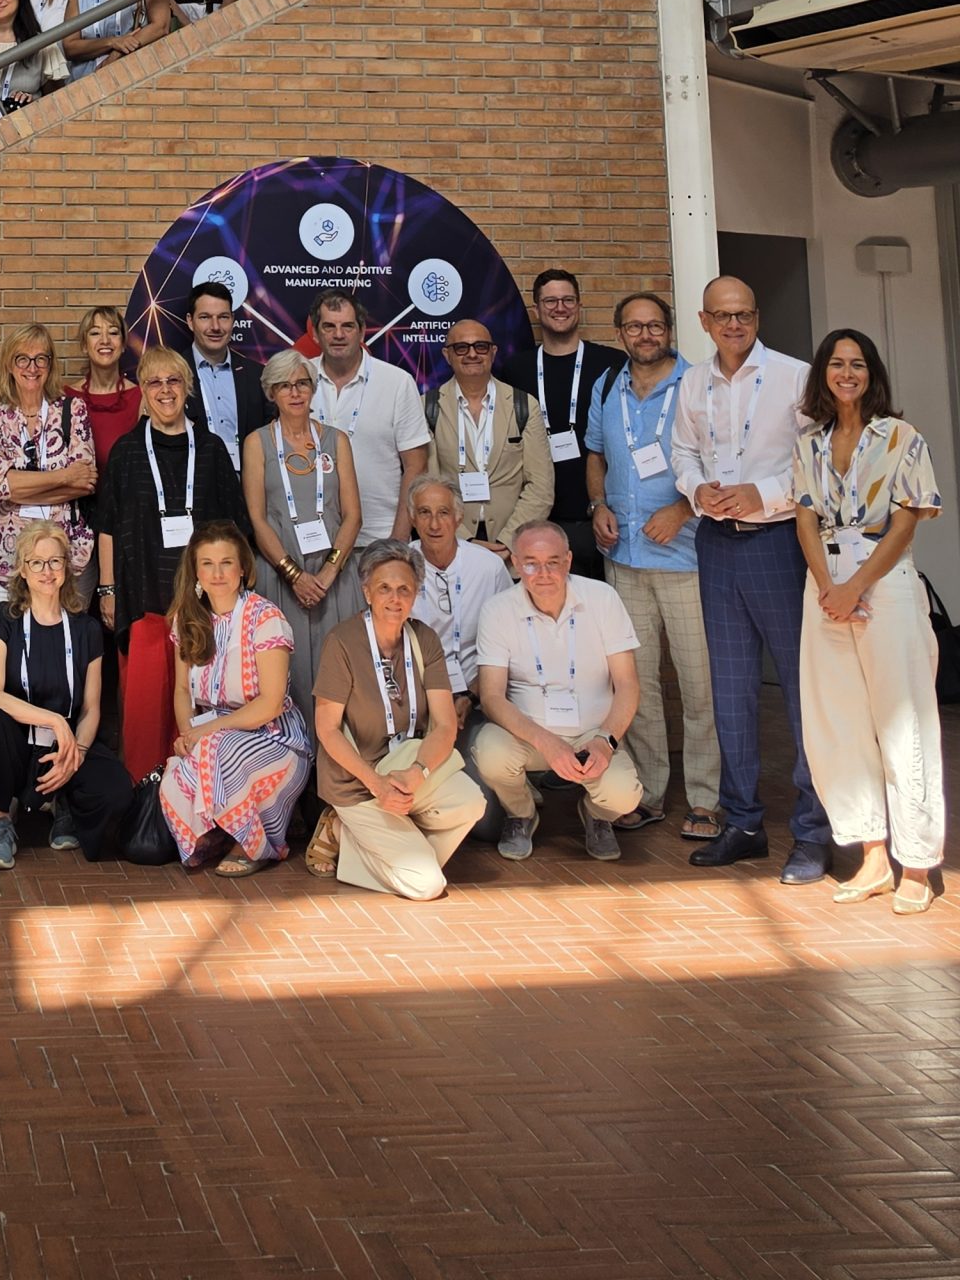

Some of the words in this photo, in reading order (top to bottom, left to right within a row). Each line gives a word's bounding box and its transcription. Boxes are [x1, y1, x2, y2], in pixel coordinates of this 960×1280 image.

[263, 265, 320, 274] ADVANCED
[321, 265, 344, 275] AND
[345, 266, 393, 275] ADDITIVE
[285, 278, 372, 288] MANUFACTURING
[232, 320, 253, 329] ART
[409, 321, 455, 330] ARTIFICI
[402, 334, 447, 343] INTELLIG
